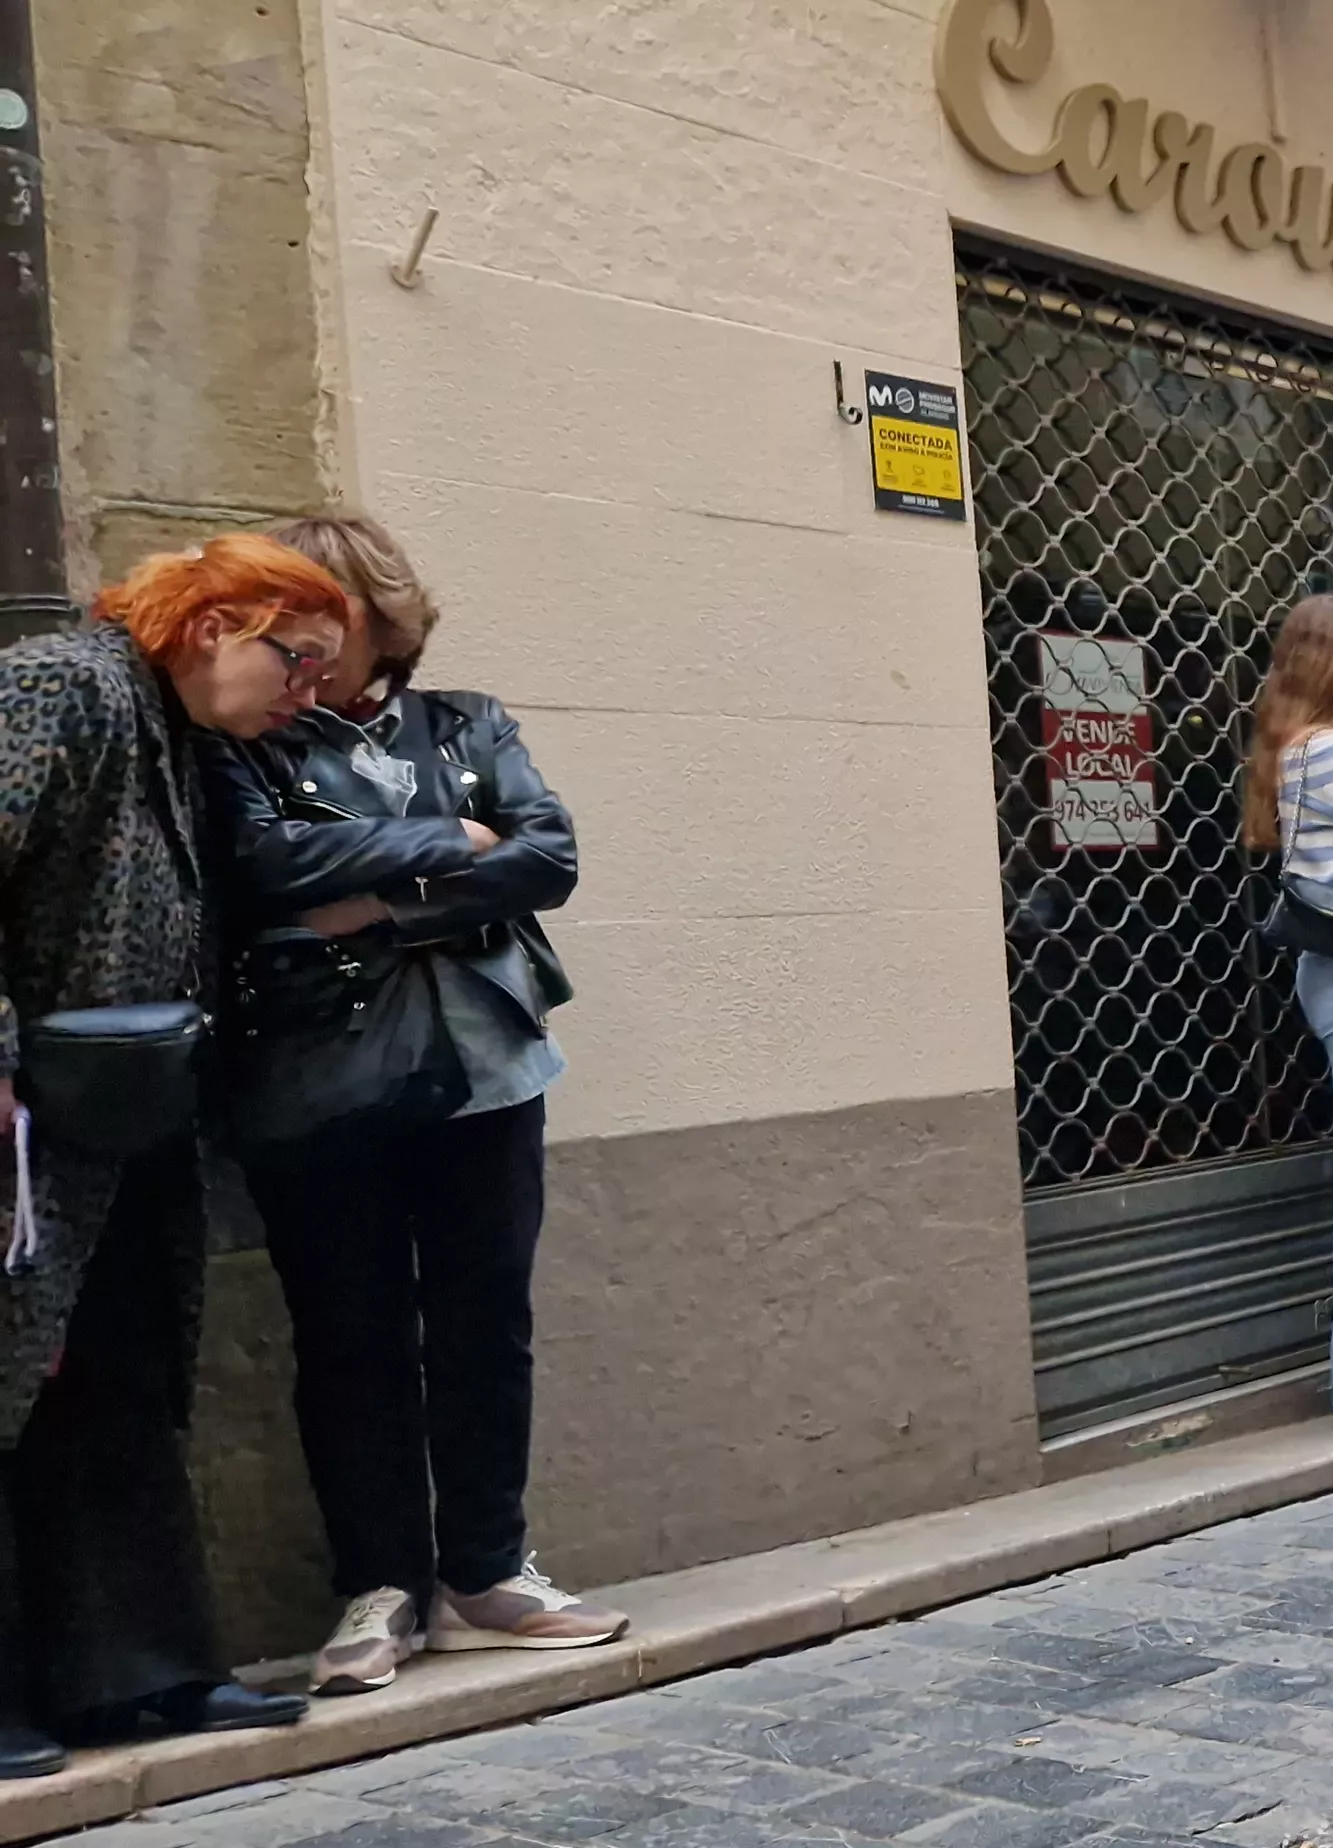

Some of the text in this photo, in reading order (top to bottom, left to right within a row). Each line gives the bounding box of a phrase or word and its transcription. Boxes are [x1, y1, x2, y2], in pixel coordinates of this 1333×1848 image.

[879, 427, 953, 452] CONECTADA
[1062, 718, 1136, 745] VENDE
[1064, 751, 1135, 779] LOCAL
